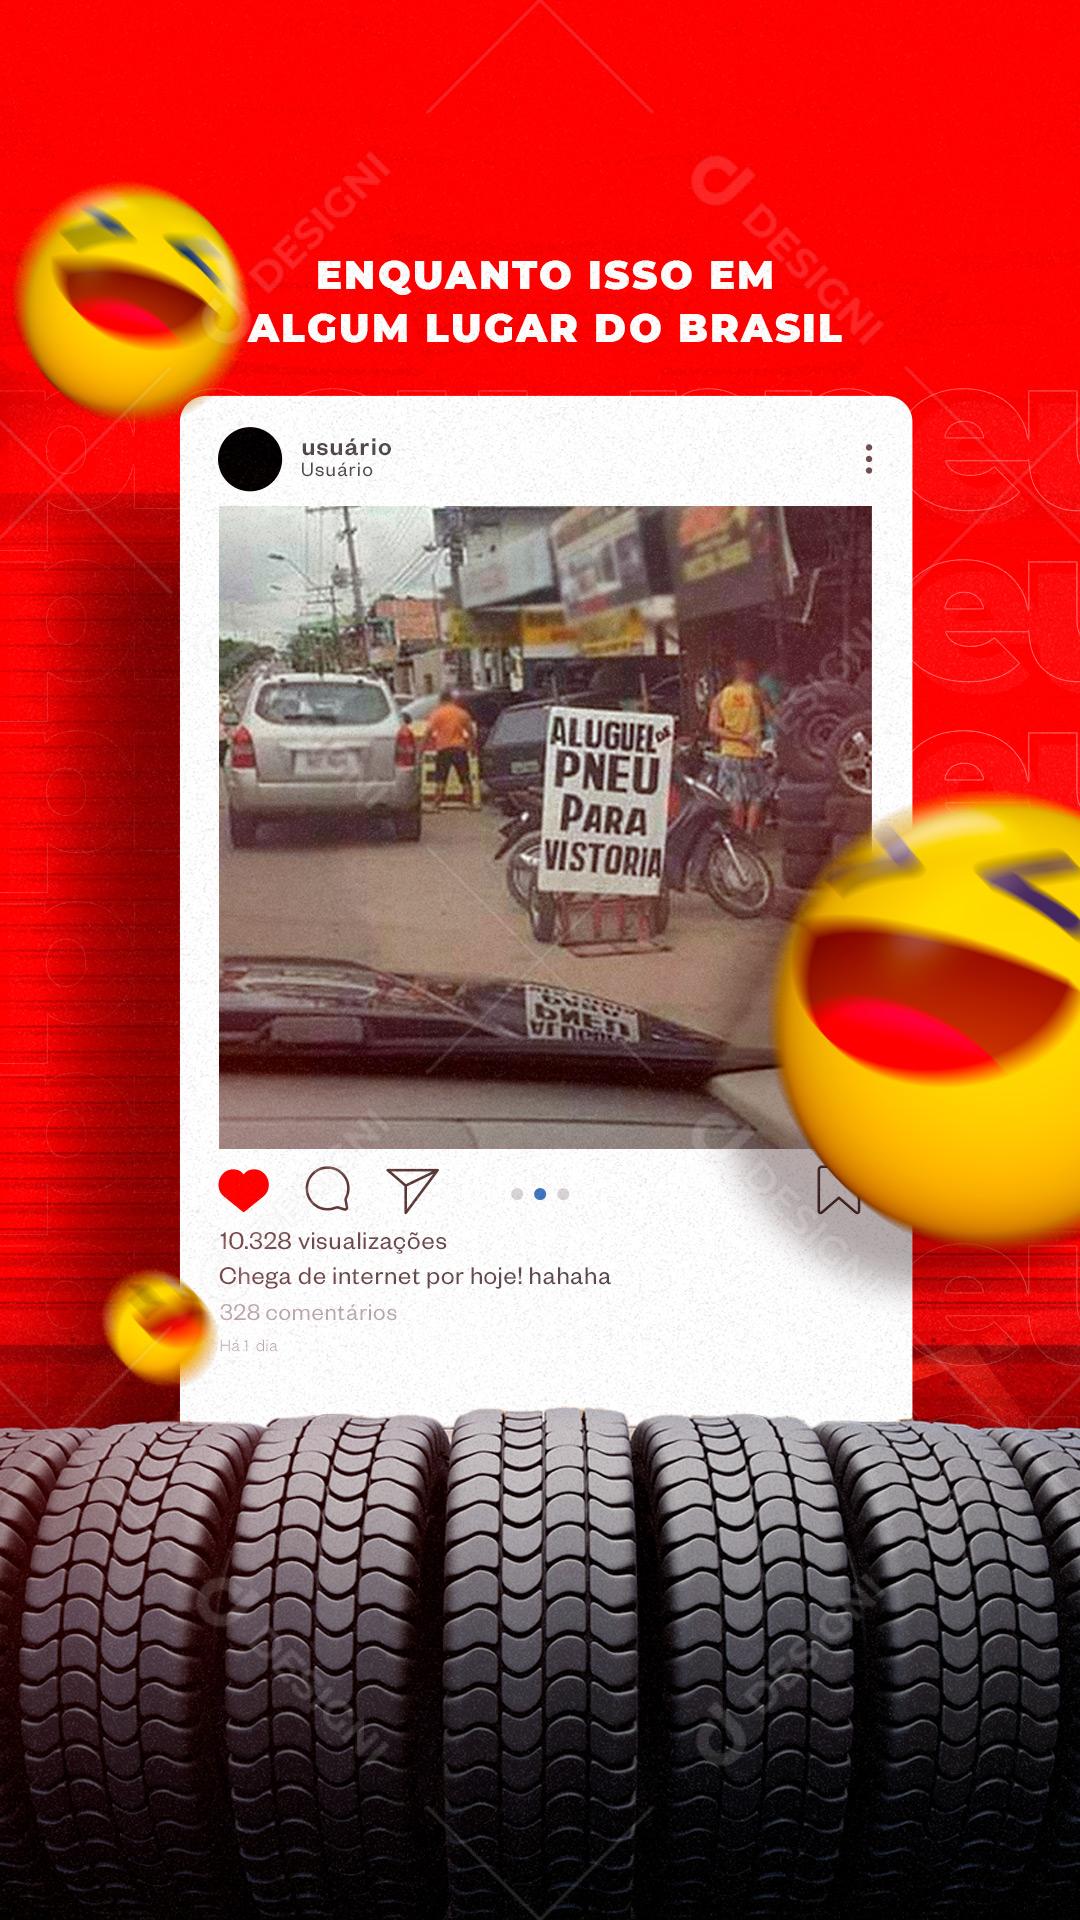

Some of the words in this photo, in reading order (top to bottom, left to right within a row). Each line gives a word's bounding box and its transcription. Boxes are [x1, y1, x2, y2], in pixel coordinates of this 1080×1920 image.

[551, 716, 656, 753] ALUGUEL
[554, 749, 660, 796] PNEU
[560, 793, 648, 836] PARA
[545, 839, 662, 878] VISTORIA
